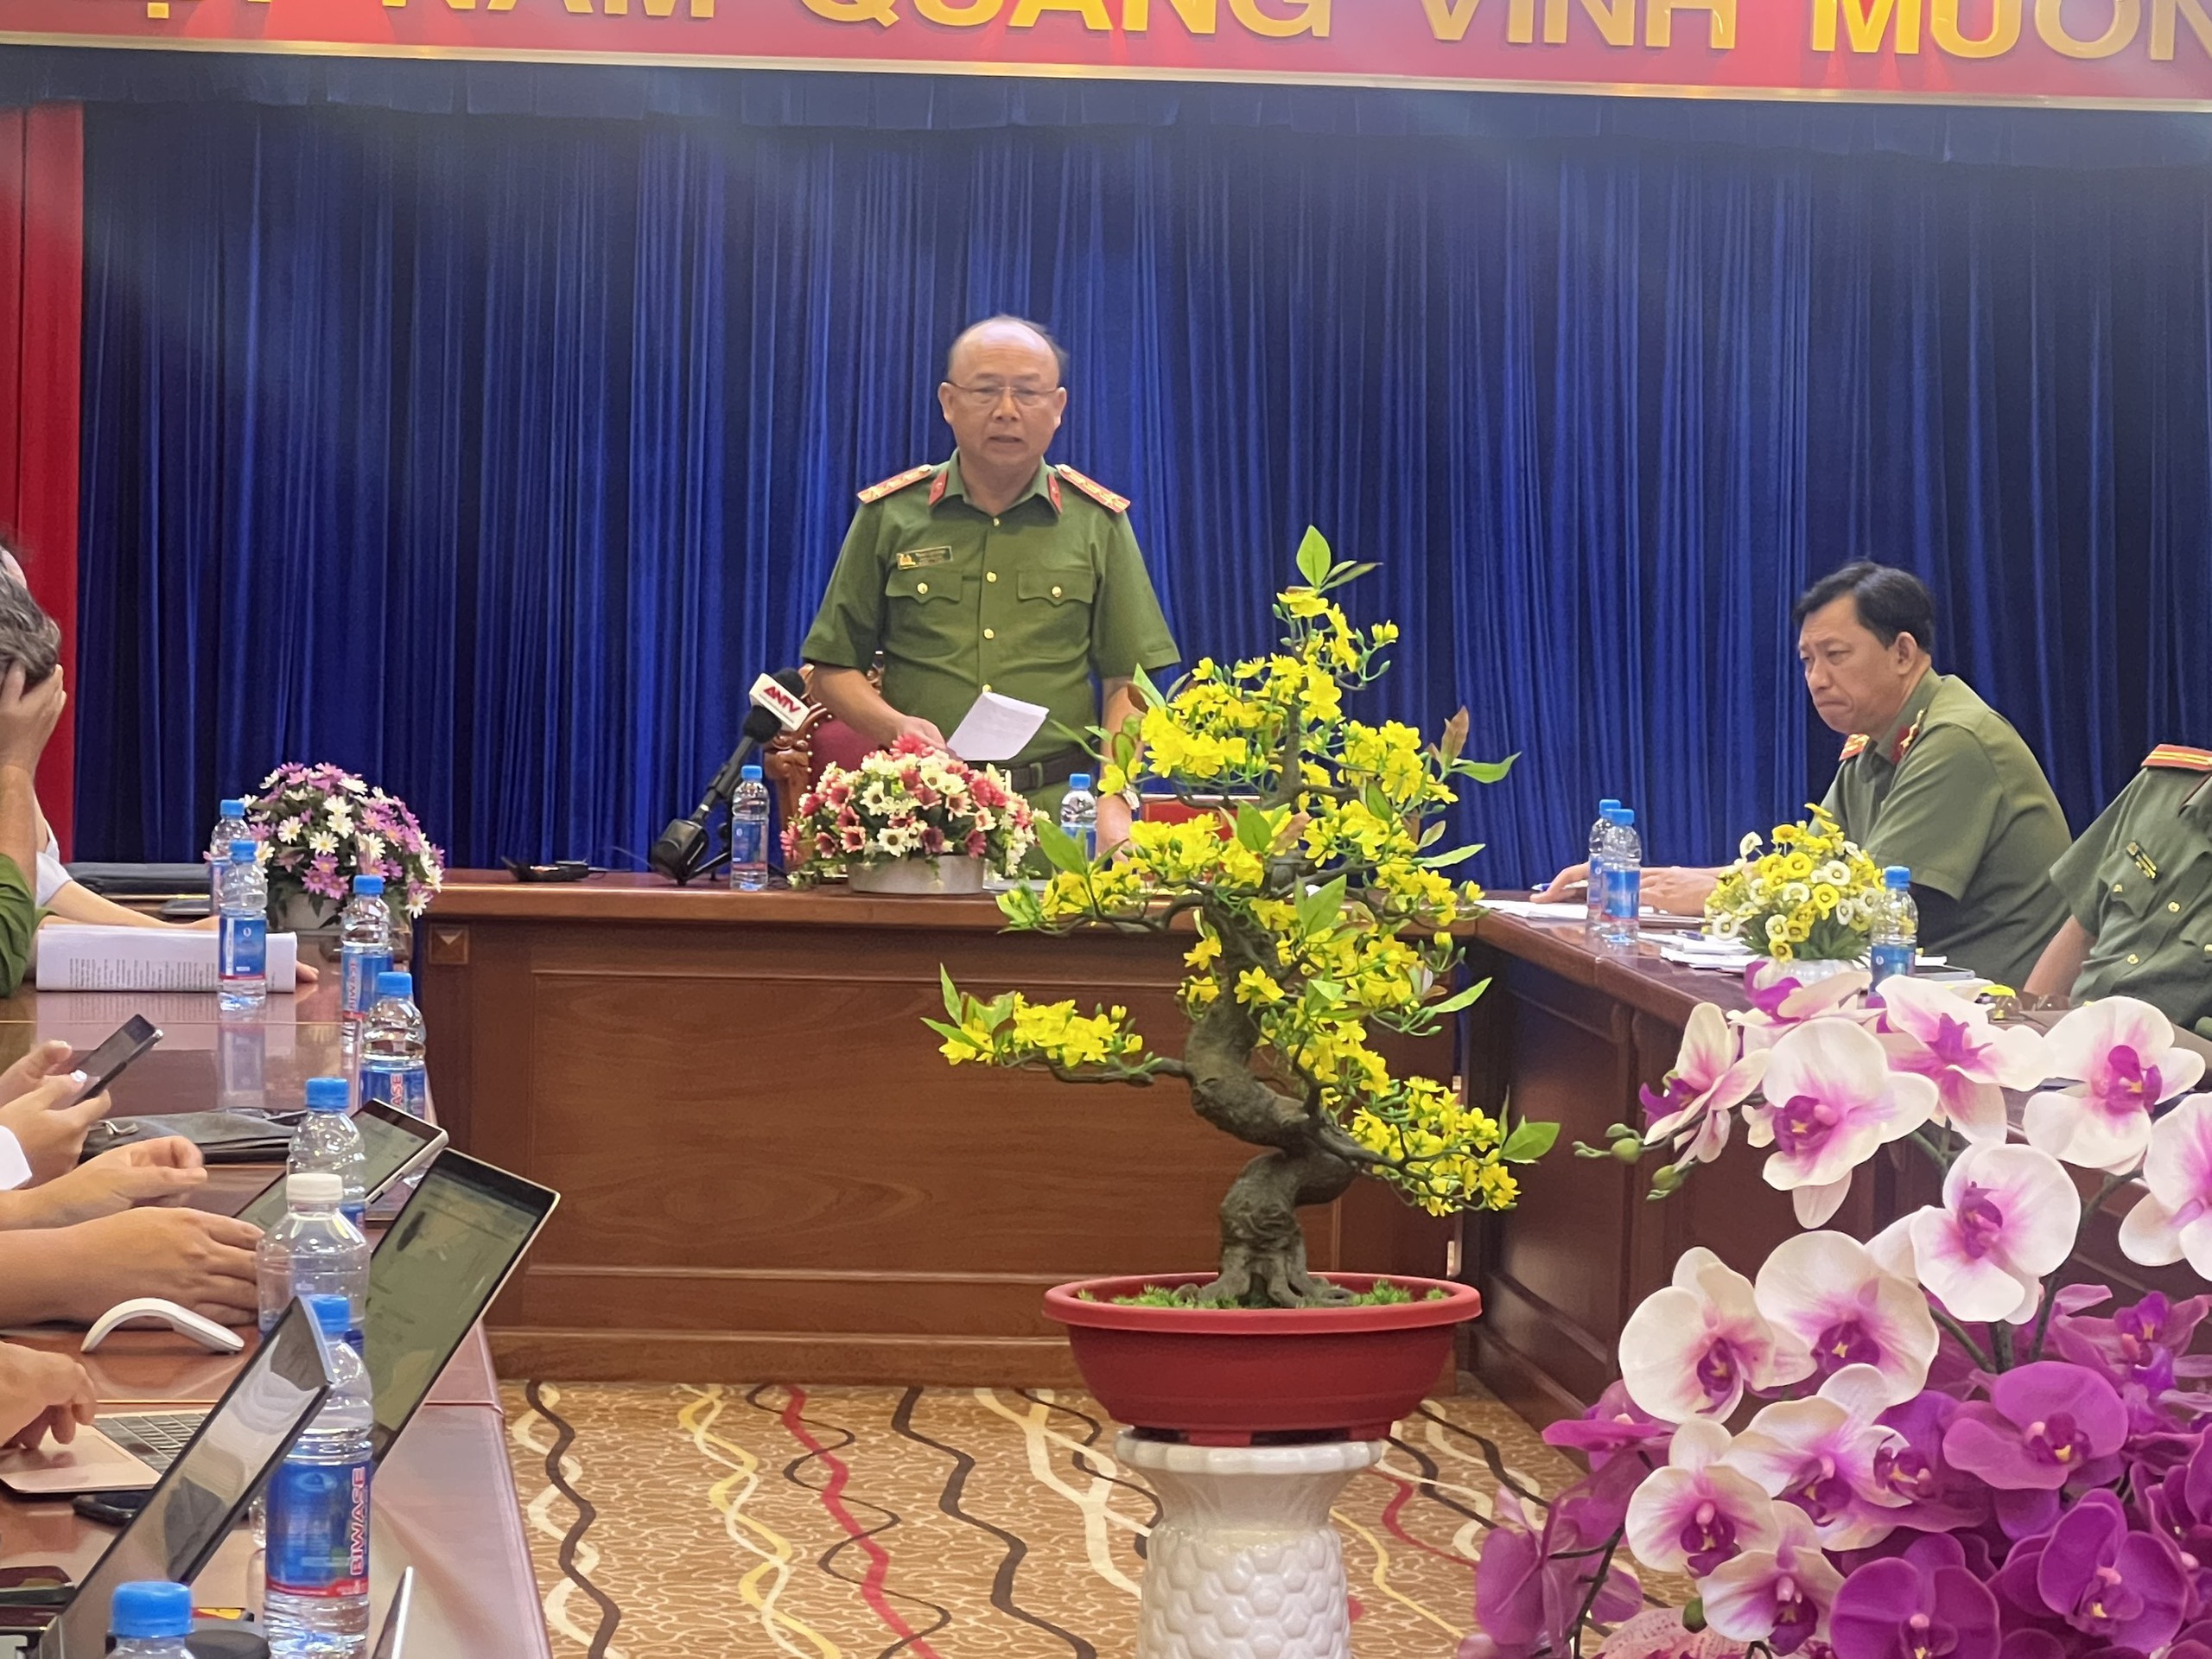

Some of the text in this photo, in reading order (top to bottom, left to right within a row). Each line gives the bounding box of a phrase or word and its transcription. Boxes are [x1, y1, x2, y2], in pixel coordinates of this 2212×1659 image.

[763, 685, 801, 714] ANTV
[391, 1072, 404, 1107] ASE
[350, 1466, 366, 1576] BIWASE
